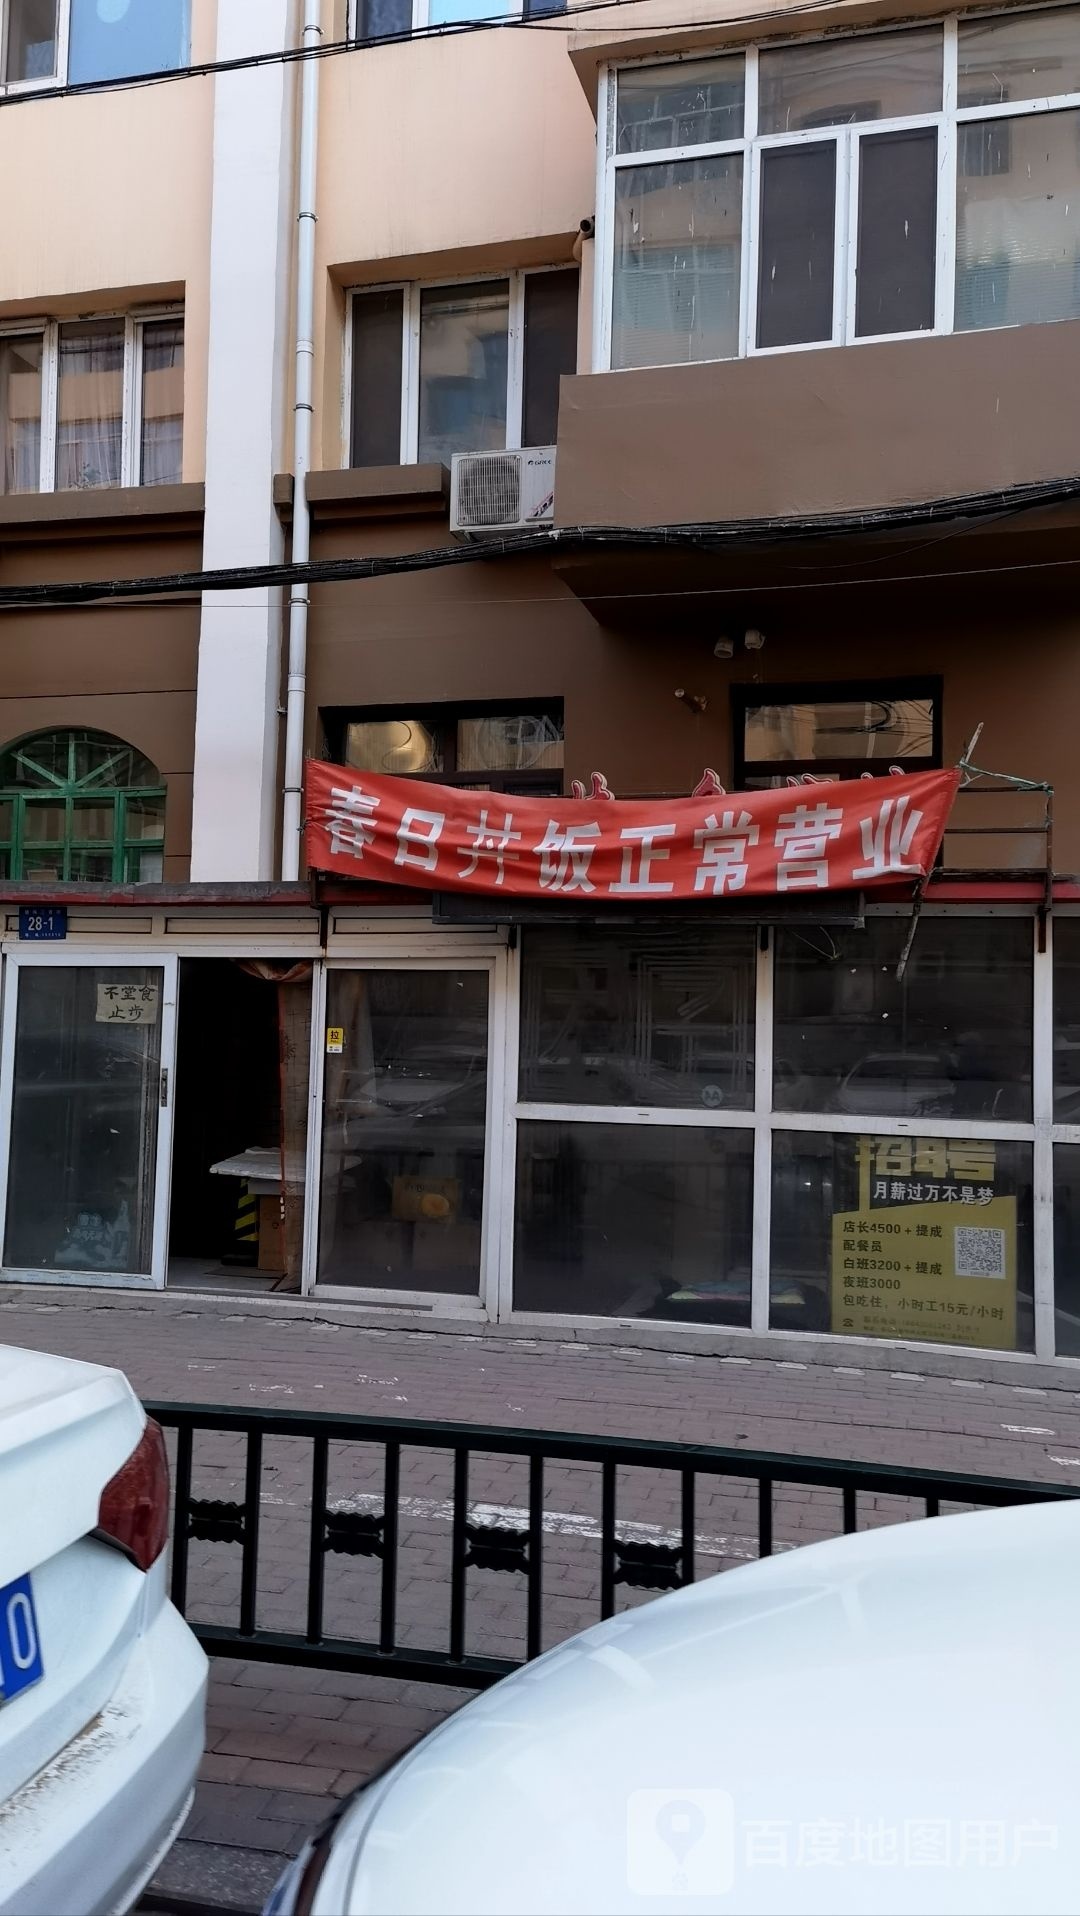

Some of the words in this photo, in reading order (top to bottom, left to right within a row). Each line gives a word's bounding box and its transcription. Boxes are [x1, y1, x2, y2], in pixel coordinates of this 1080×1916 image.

[323, 785, 924, 896] 春日丼饭正常营业
[28, 916, 53, 931] 28-1
[104, 985, 155, 1002] 不堂食
[108, 1004, 144, 1022] 止步
[330, 1030, 340, 1040] 拉
[873, 1181, 994, 1207] 月薪过万不是梦
[843, 1239, 882, 1253] 配餐员
[843, 1275, 901, 1290] 夜班3000
